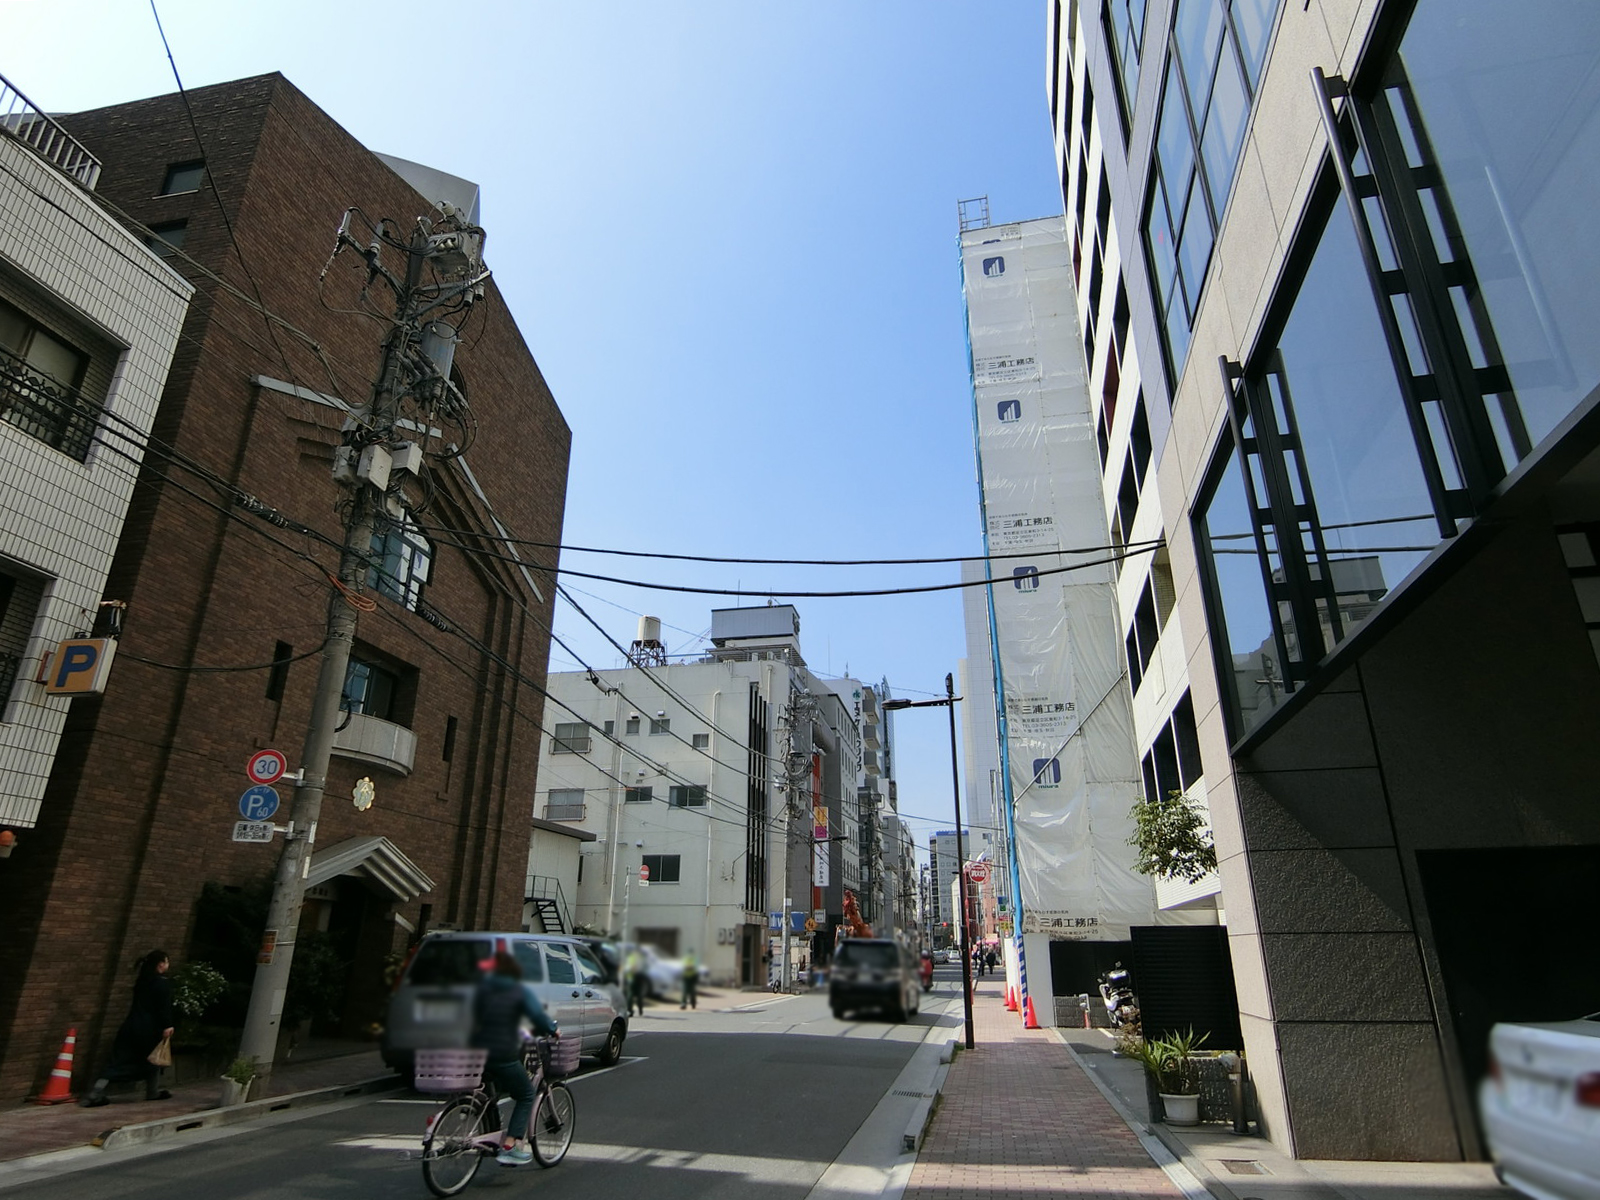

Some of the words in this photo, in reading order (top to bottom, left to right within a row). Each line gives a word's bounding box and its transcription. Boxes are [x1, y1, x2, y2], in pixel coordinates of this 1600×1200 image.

[988, 357, 1035, 370] 三浦工務店
[1003, 516, 1053, 529] 三浦工務店
[55, 645, 97, 687] P
[1022, 702, 1076, 714] 三浦工務店
[256, 760, 278, 774] 30
[247, 795, 264, 816] P
[257, 806, 269, 817] 60
[1039, 917, 1098, 928] 三浦工務店
